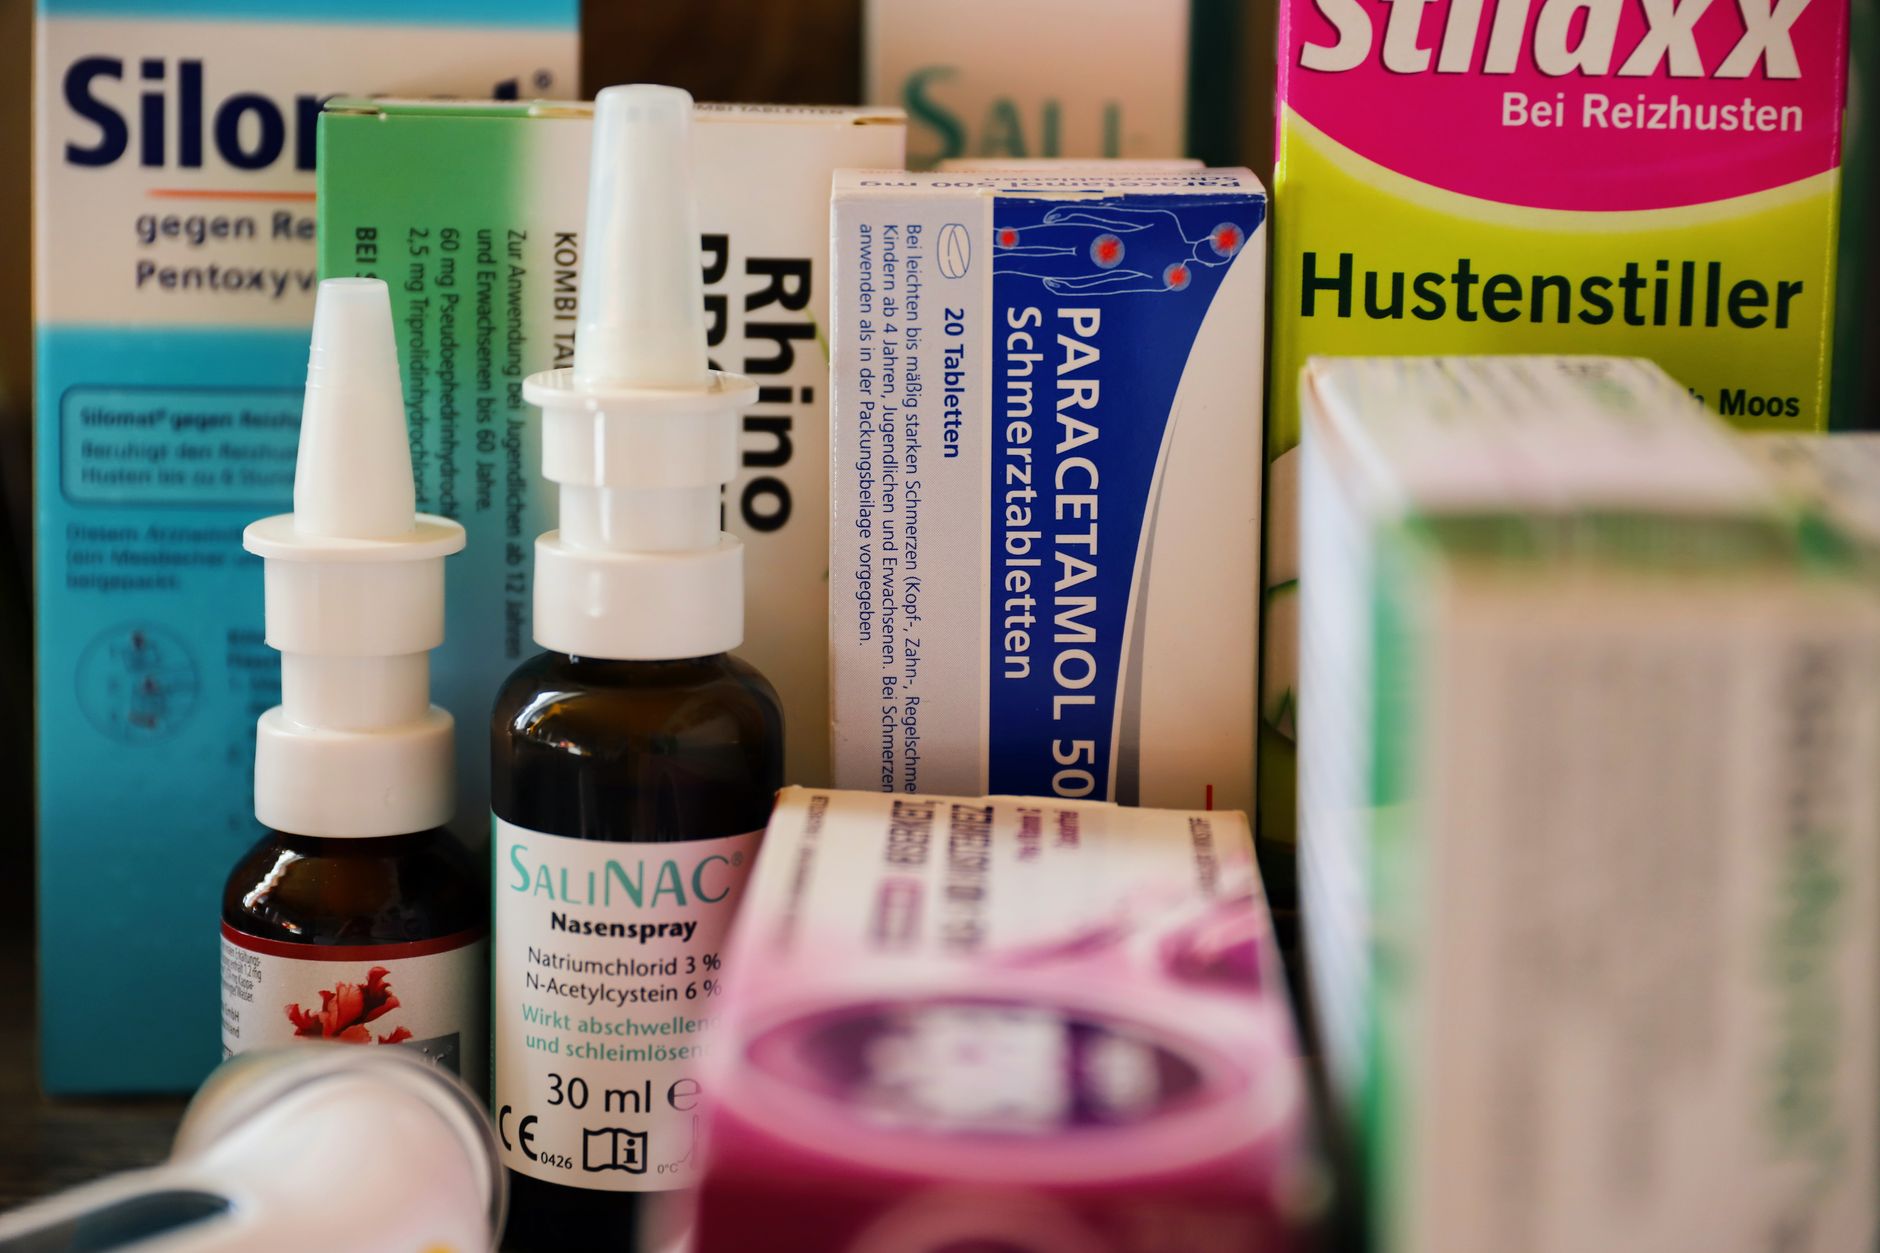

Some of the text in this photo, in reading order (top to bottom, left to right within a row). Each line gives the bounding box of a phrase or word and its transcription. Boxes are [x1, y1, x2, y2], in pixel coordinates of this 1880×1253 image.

[1502, 91, 1804, 132] Bei Reizhusten
[135, 214, 255, 246] gegen
[355, 227, 377, 264] BEI
[406, 227, 429, 256] 2,5
[440, 227, 460, 251] 60
[476, 228, 497, 264] und
[507, 228, 527, 260] Zur
[905, 224, 922, 250] Bei
[405, 262, 424, 292] mg
[435, 257, 454, 287] mg
[554, 231, 578, 321] KOMBI
[905, 255, 923, 322] leichten
[1300, 251, 1805, 330] Hustenstiller
[476, 270, 497, 392] Erwachsenen
[502, 263, 526, 377] Anwendung
[905, 327, 922, 351] bis
[506, 382, 525, 410] bei
[741, 256, 817, 534] Rhino
[902, 356, 922, 408] mäßig
[943, 307, 965, 459] 20 Tabletten
[476, 397, 497, 424] bis
[1719, 388, 1800, 417] Moos
[476, 428, 495, 453] 60
[855, 224, 876, 646] anwenden als in der Packungsbeilage vorgegeben.
[905, 413, 922, 474] starken
[502, 417, 527, 537] Jugendlichen
[1004, 305, 1044, 680] Schmerztabletten
[878, 224, 899, 794] Kindern ab 4 Jahren, Jugendlichen und Erwachsenen. Bei Schmerzen
[905, 480, 922, 570] Schmerzen
[1051, 306, 1101, 721] PARACETAMOL
[505, 571, 526, 594] 12
[901, 575, 922, 633] (Kopf-,
[902, 637, 921, 690] Zahn-,
[1051, 738, 1096, 798] 50
[551, 911, 698, 945] Nasenspray
[528, 946, 722, 977] Natriumchlorid 3 %
[526, 972, 678, 1008] N-Acetylcystein
[685, 982, 697, 1000] 6
[522, 1003, 571, 1031] Wirkt
[526, 1034, 560, 1055] und
[546, 1073, 589, 1110] 30
[604, 1080, 651, 1114] ml
[540, 1152, 573, 1170] 0426
